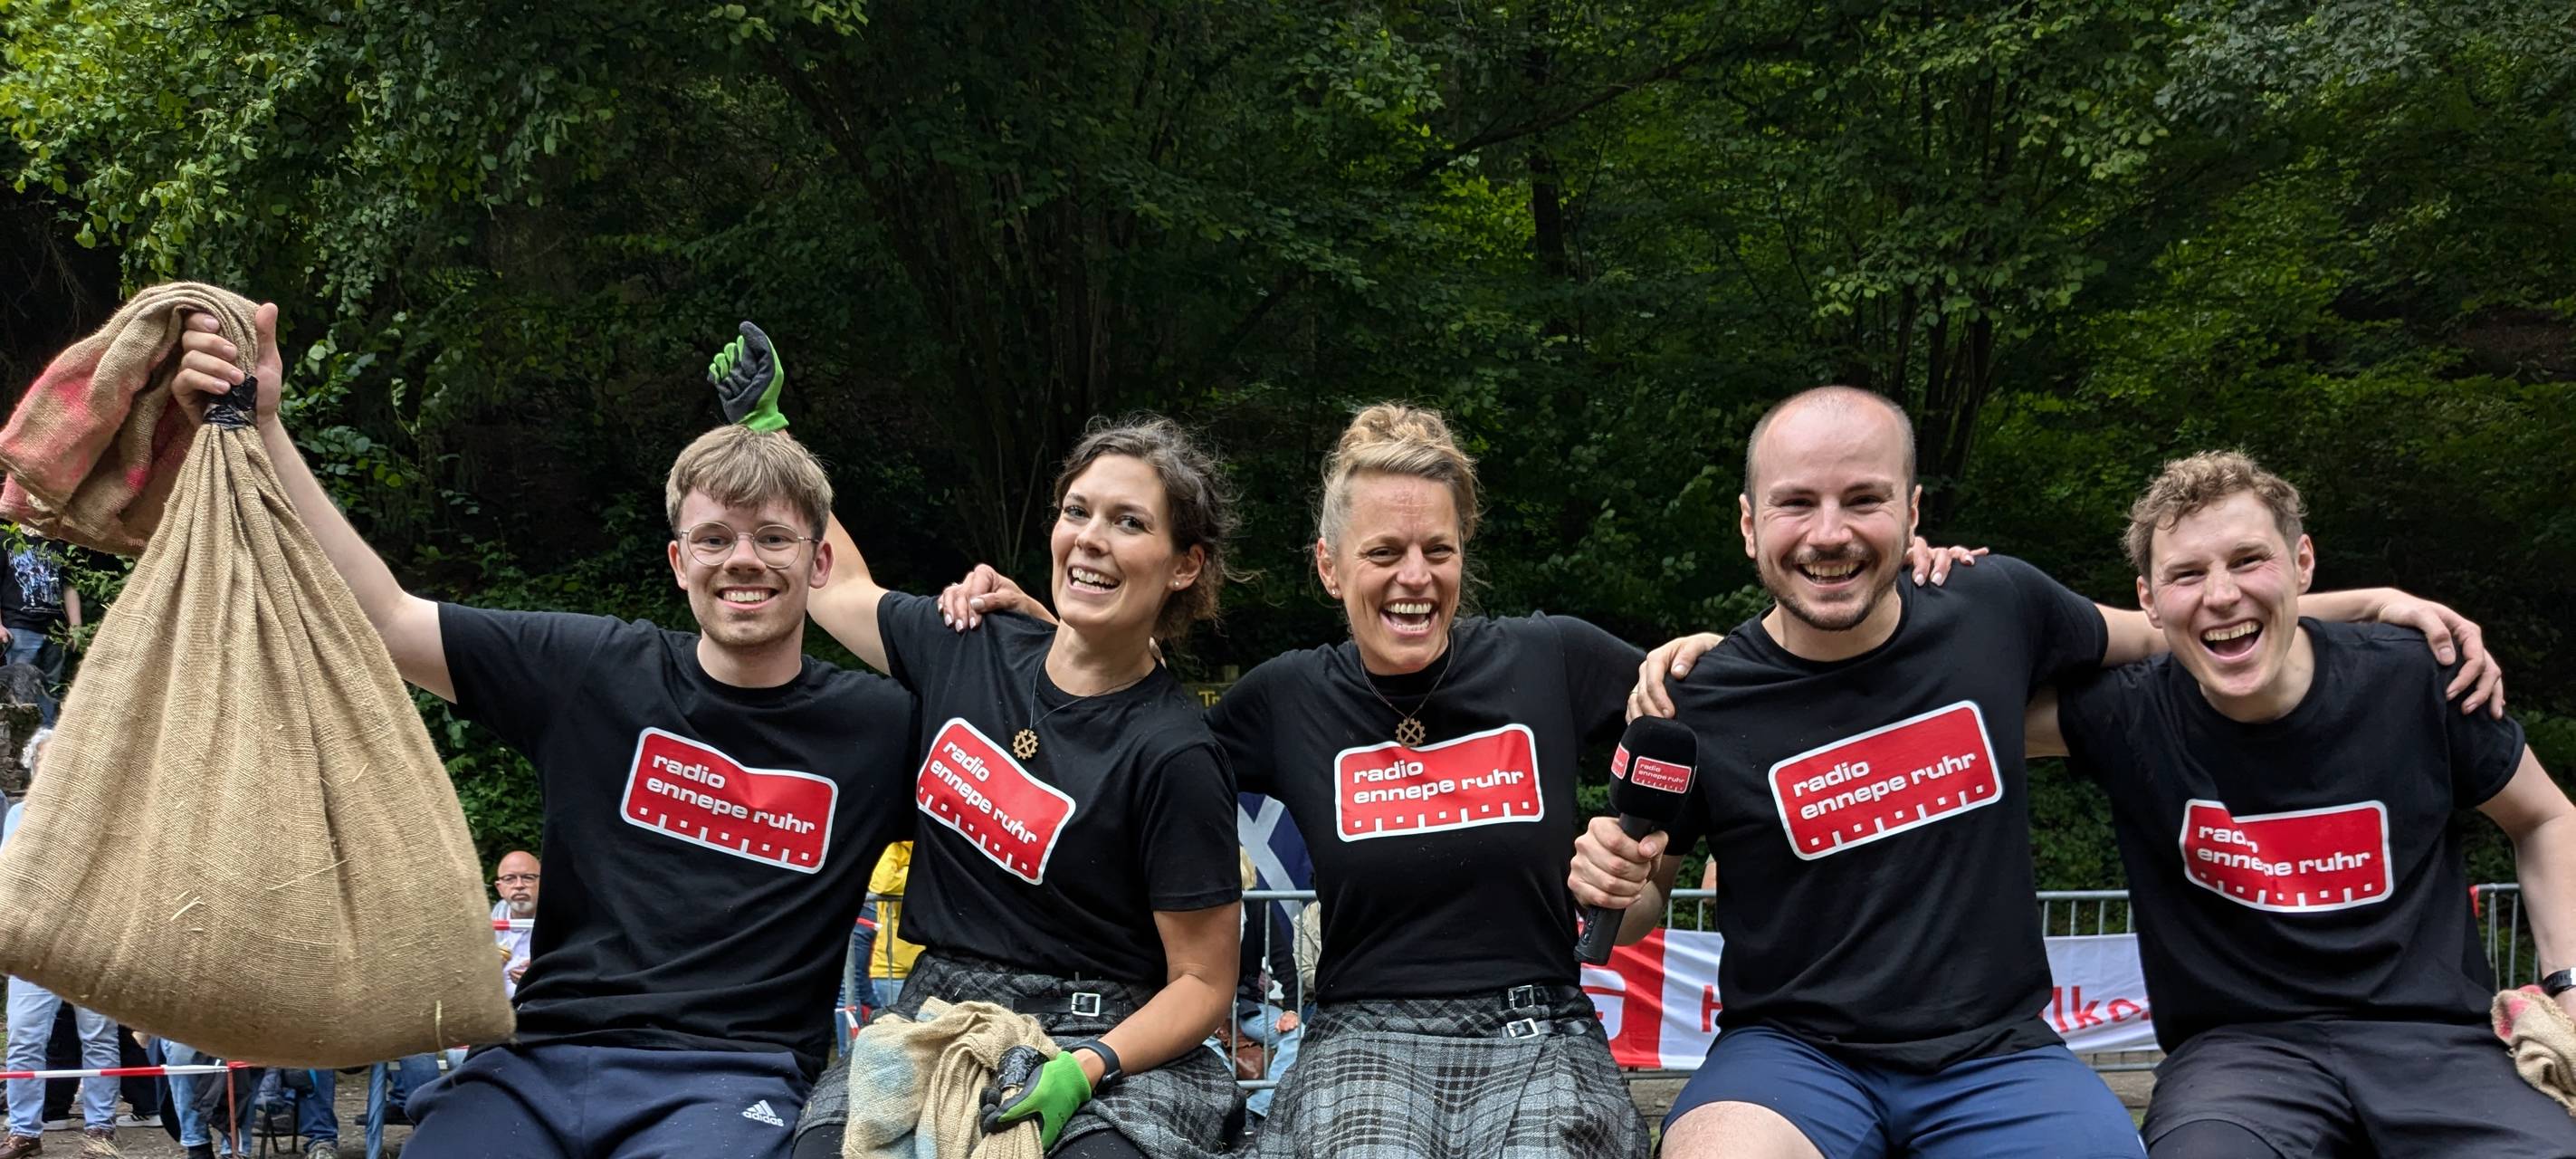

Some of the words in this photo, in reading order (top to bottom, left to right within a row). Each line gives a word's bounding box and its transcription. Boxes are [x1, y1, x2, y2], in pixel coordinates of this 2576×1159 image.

[652, 753, 726, 790] radio
[943, 741, 990, 782] radio
[1353, 760, 1424, 783] radio
[1638, 770, 1667, 781] ennepe
[1667, 776, 1684, 784] ruhr
[1639, 763, 1661, 772] radio
[1793, 761, 1870, 797] radio
[930, 760, 992, 814] ennepe
[993, 807, 1037, 844] ruhr
[1353, 779, 1455, 804] ennepe
[1461, 769, 1524, 790] ruhr
[1800, 774, 1907, 819] ennepe
[1910, 752, 1976, 784] ruhr
[646, 777, 749, 819] ennepe
[752, 809, 815, 835] ruhr
[2299, 851, 2371, 873] ruhr
[742, 1111, 785, 1127] adidas
